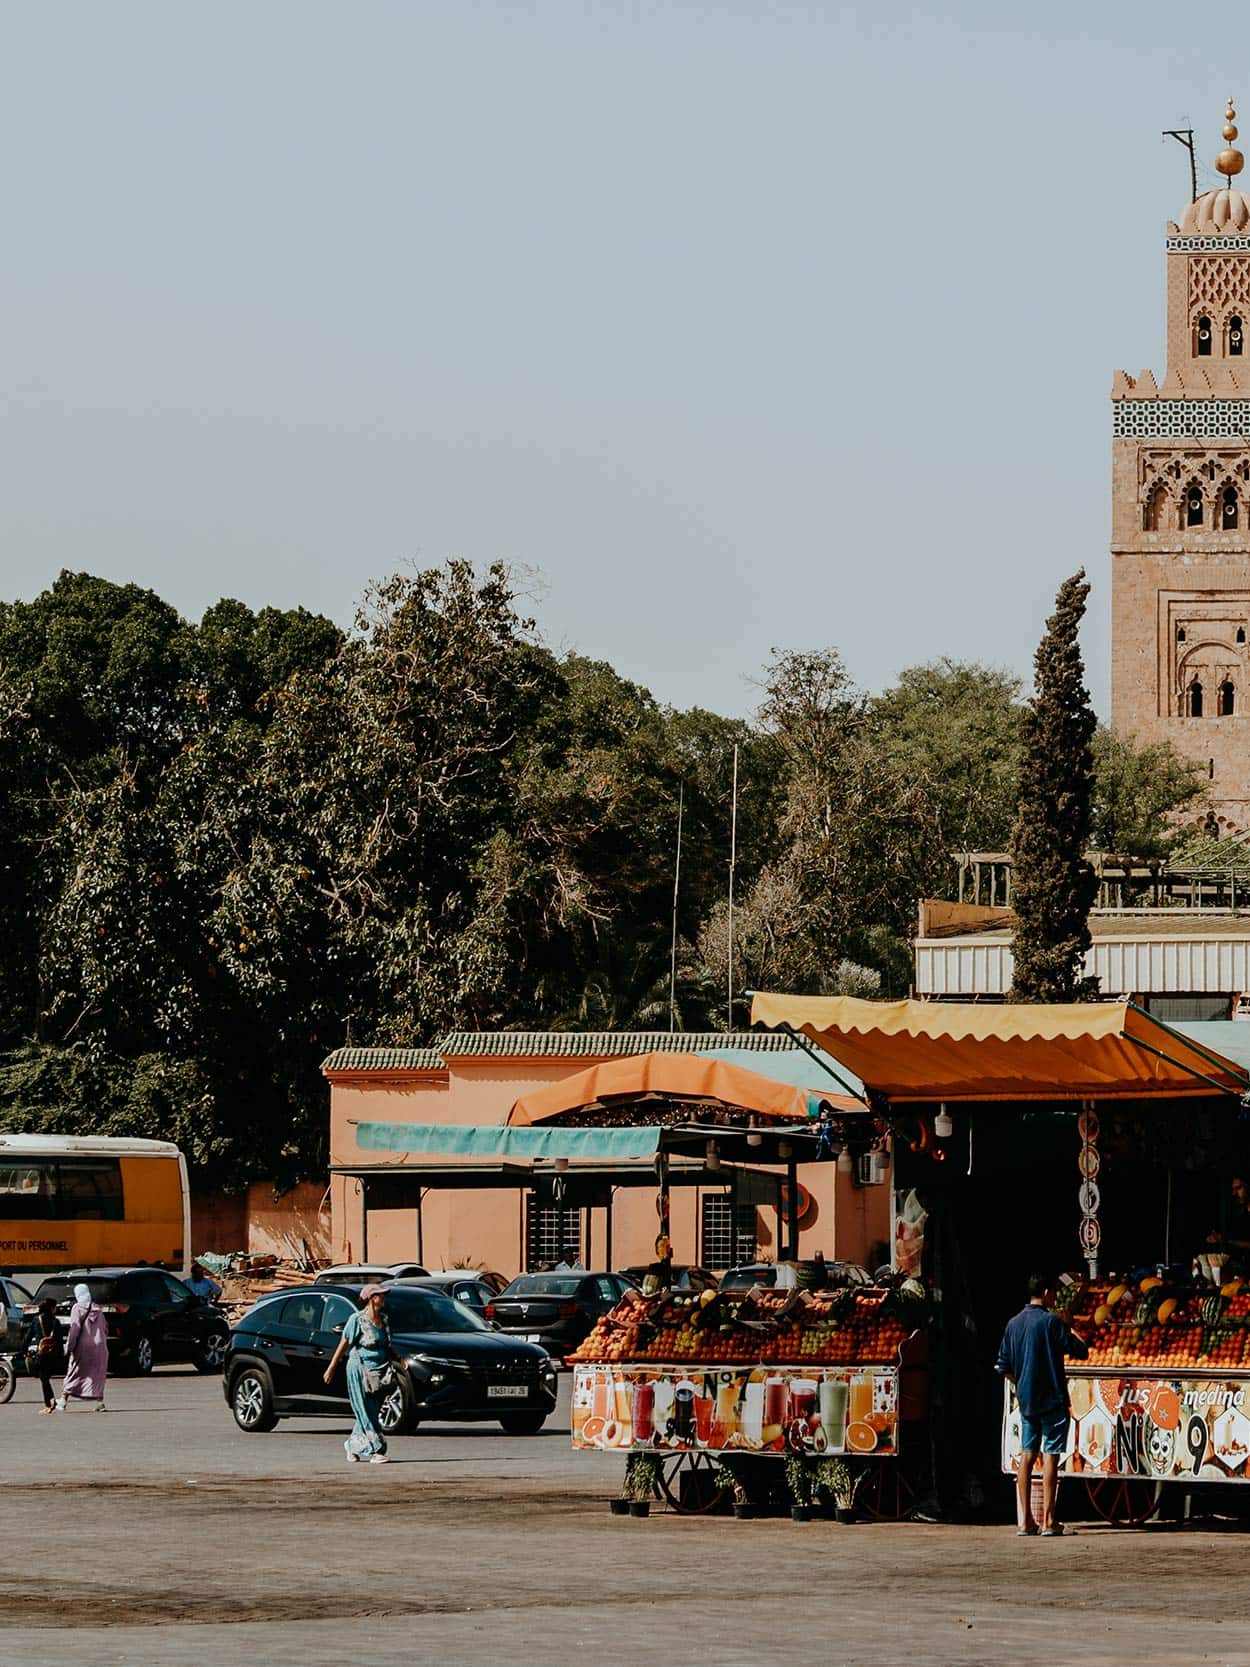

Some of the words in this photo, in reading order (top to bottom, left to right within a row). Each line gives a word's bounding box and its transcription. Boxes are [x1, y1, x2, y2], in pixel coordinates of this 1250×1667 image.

[17, 1240, 27, 1250] DU
[28, 1240, 68, 1251] PERSONNEL
[1183, 1385, 1246, 1410] medina
[1186, 1413, 1209, 1478] 9
